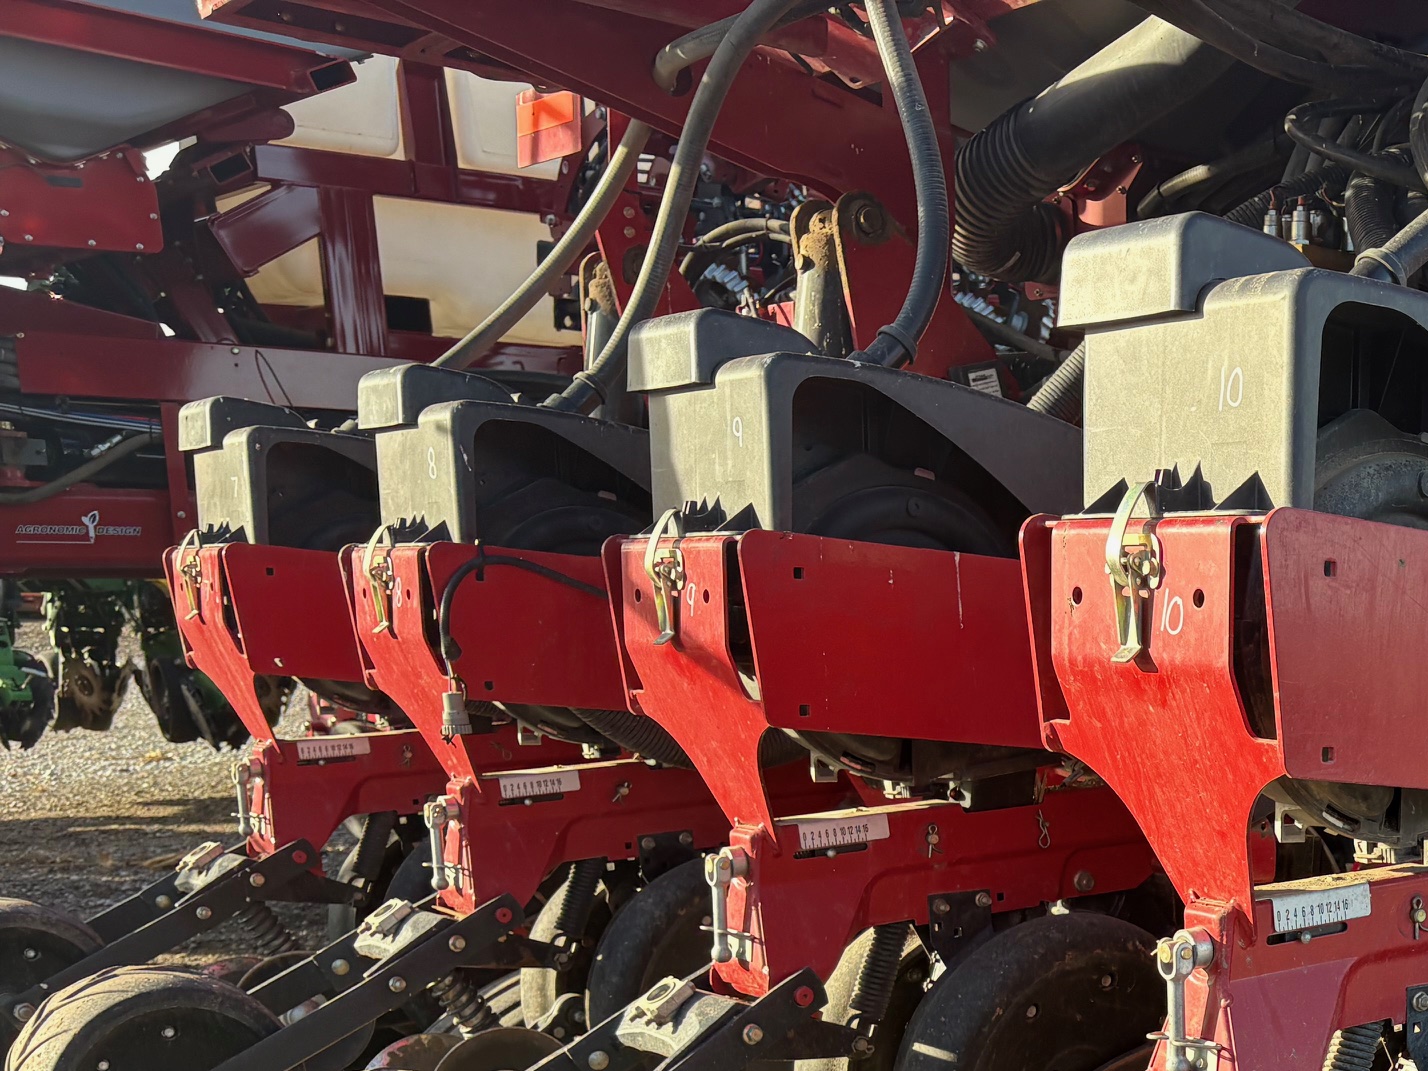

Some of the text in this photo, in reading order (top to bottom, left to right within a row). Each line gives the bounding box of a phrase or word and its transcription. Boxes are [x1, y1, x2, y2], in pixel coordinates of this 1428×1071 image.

[1219, 366, 1243, 412] 10
[732, 416, 743, 447] 9
[427, 446, 437, 480] 8
[230, 476, 238, 498] 7
[15, 525, 142, 536] AGRONOMIC DESIGN
[395, 577, 403, 608] 8
[686, 582, 696, 617] 9
[1160, 588, 1184, 636] 10
[1276, 898, 1348, 922] 0 2 4 6 8 10 12 14 16
